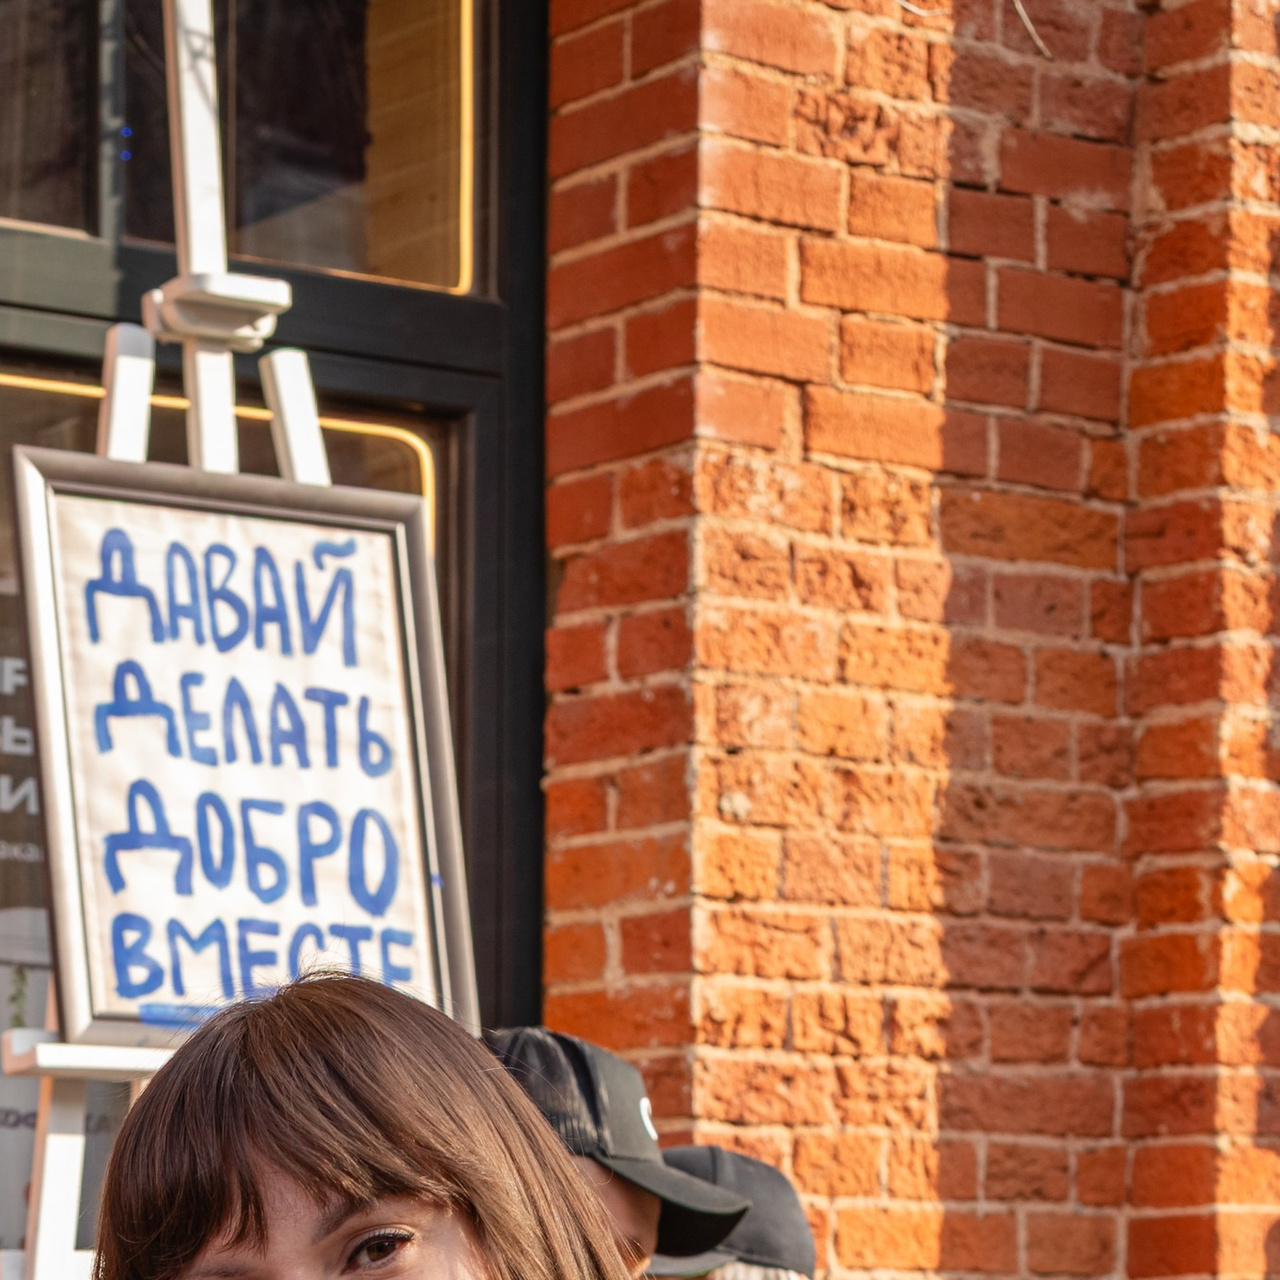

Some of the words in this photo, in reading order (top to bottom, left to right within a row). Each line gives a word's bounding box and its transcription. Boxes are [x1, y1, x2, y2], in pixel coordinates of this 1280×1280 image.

[84, 527, 358, 667] ДАВАЙ
[94, 657, 393, 778] ДЕЛАТЬ
[103, 778, 400, 917] ДОБРО
[111, 912, 414, 999] ВМЕСТЕ
